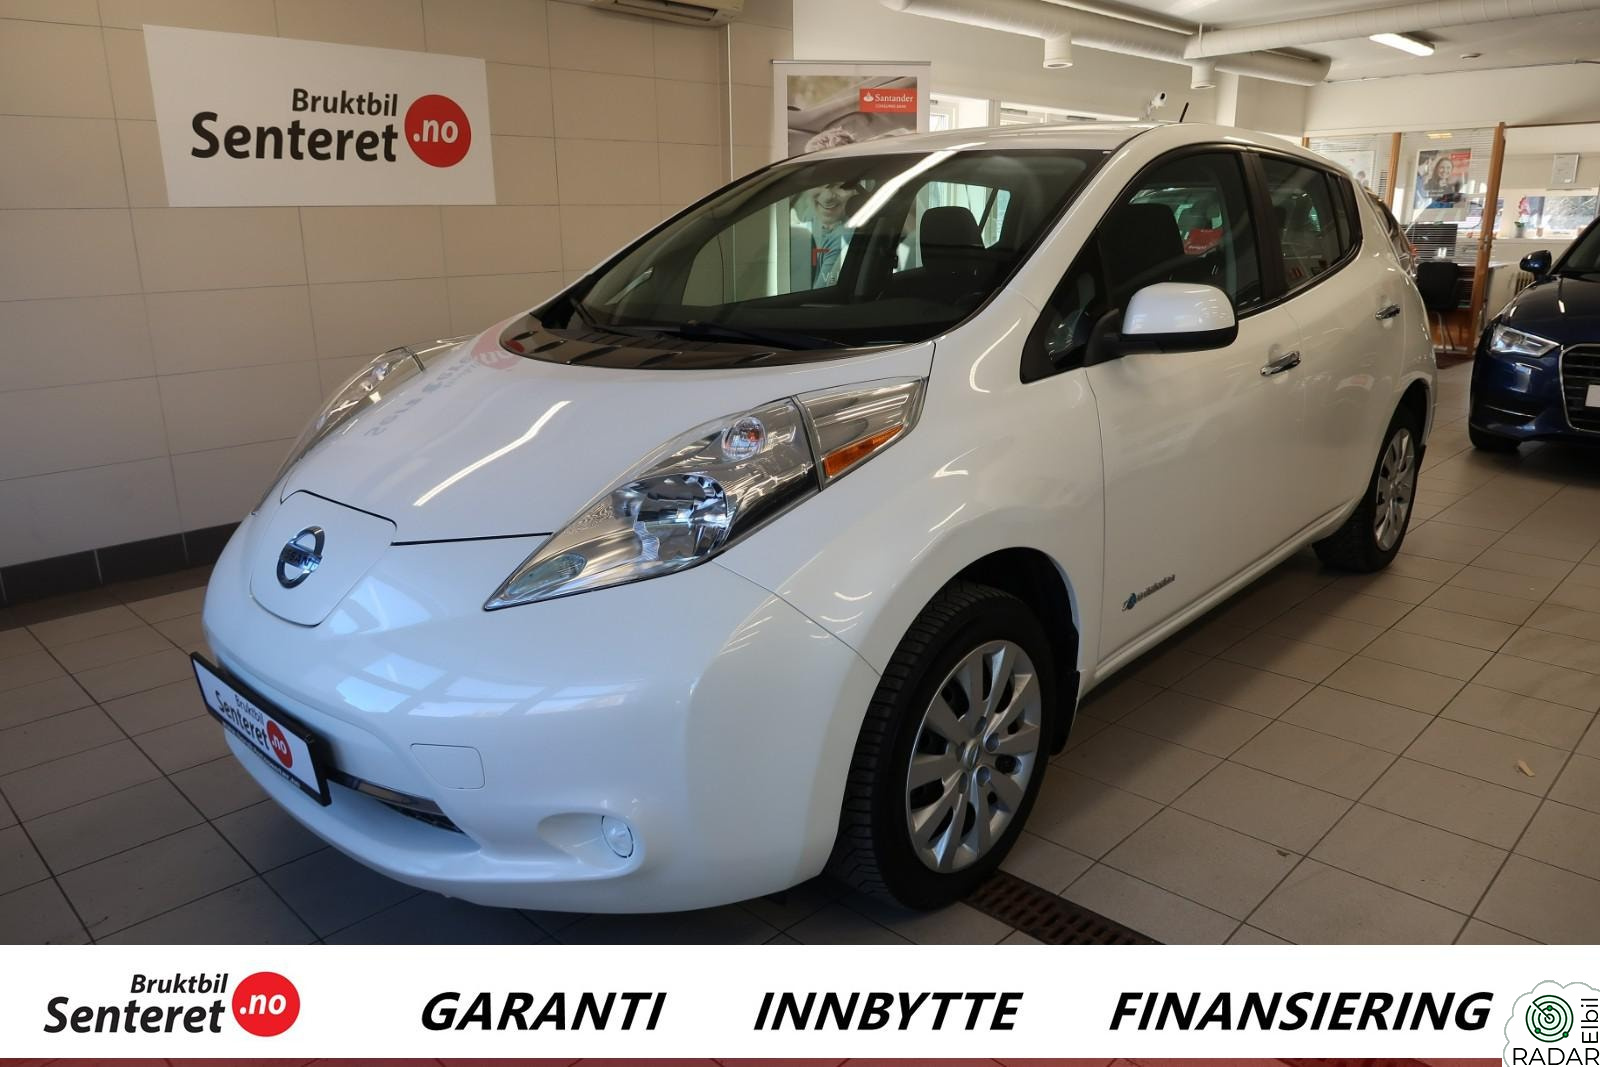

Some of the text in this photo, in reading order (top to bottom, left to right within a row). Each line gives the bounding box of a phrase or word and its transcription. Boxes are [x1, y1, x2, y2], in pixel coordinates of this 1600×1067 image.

[291, 88, 398, 117] Bruktbil
[874, 93, 914, 103] Santander
[191, 111, 459, 162] Senteret .no
[215, 690, 270, 751] Senteret
[271, 735, 288, 755] .no
[234, 694, 265, 727] Bruktbil
